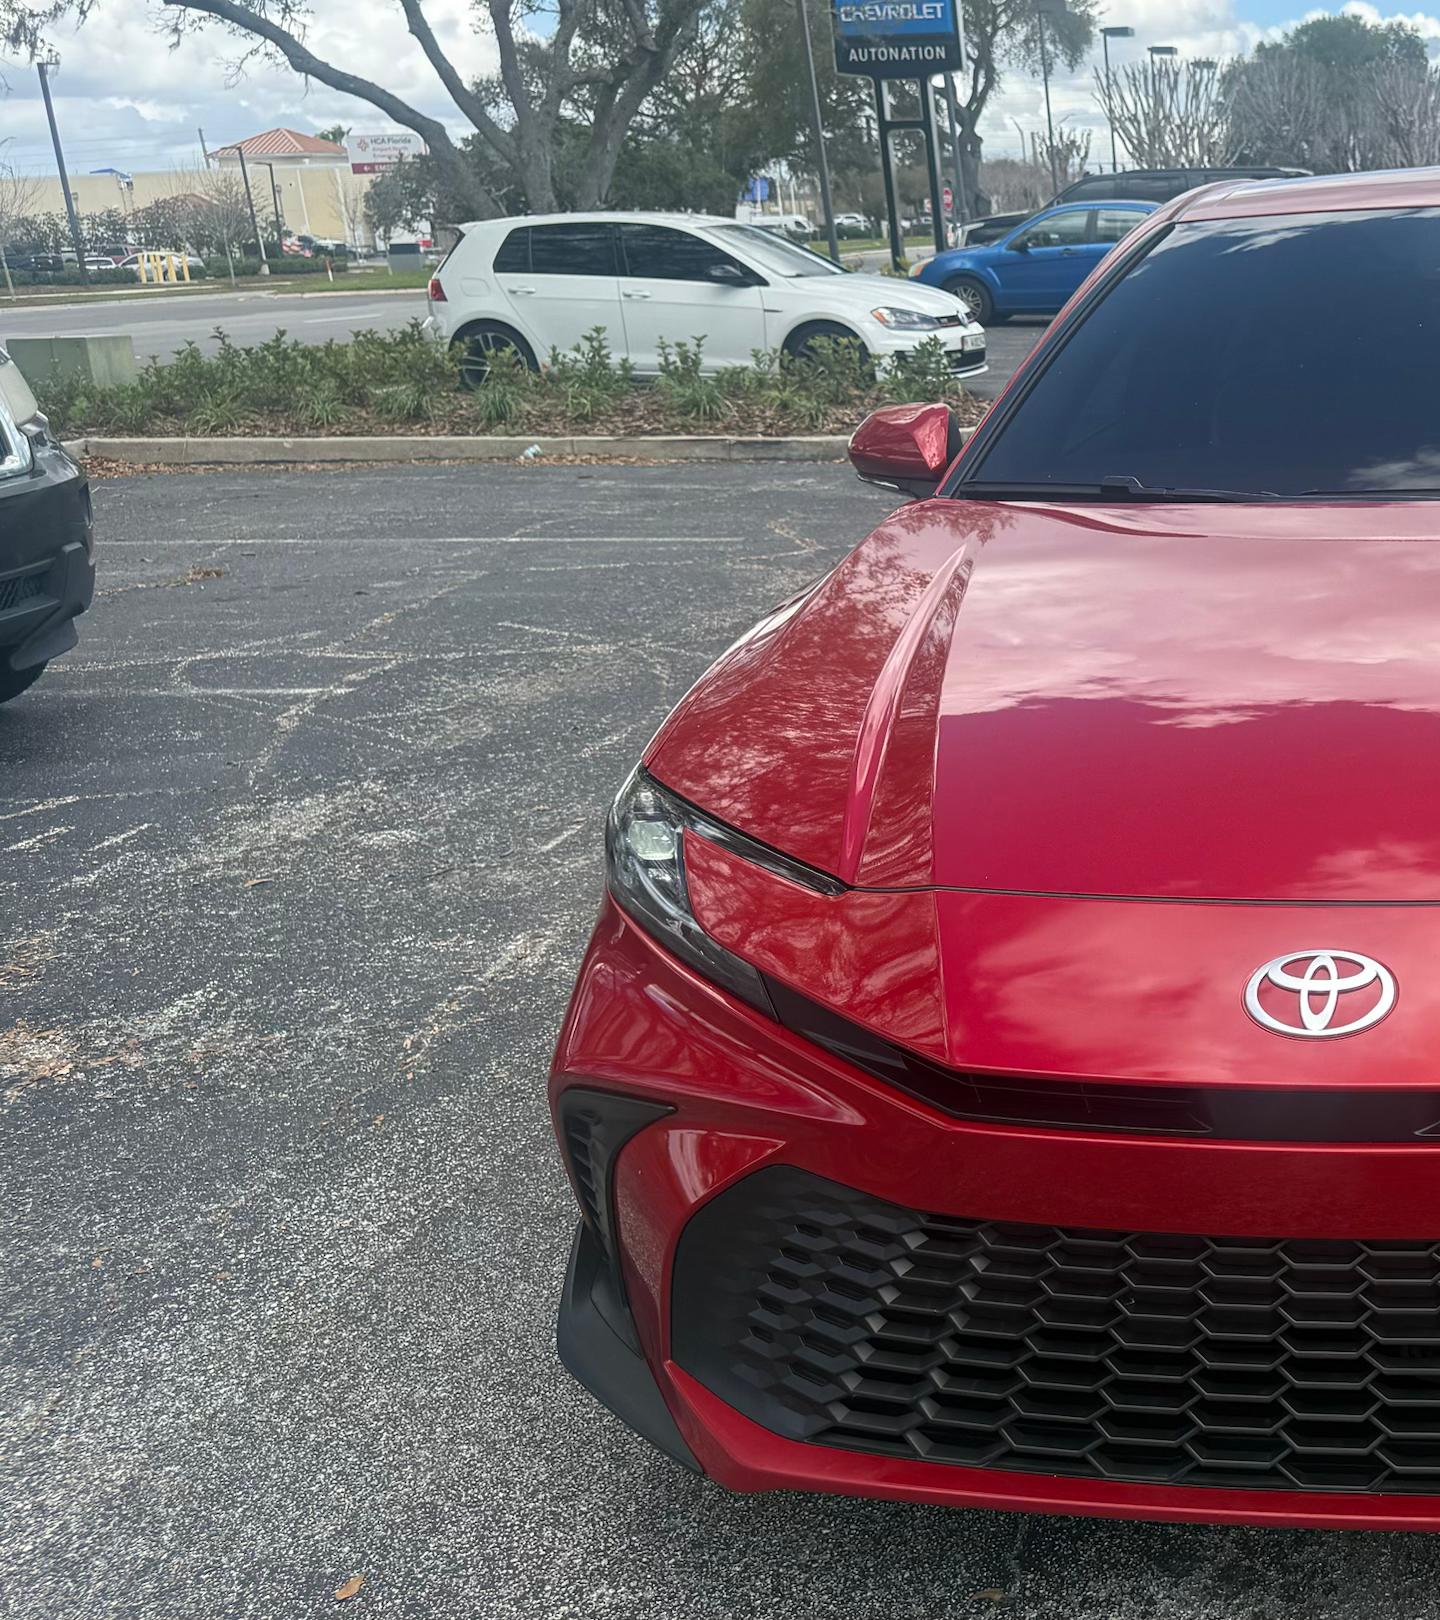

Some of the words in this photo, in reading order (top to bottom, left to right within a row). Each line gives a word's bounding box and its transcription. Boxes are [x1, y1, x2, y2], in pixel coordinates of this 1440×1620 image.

[840, 4, 944, 22] CHEVROLET
[849, 47, 946, 62] AUTONATION
[370, 137, 386, 145] HCA
[388, 136, 411, 144] Florida
